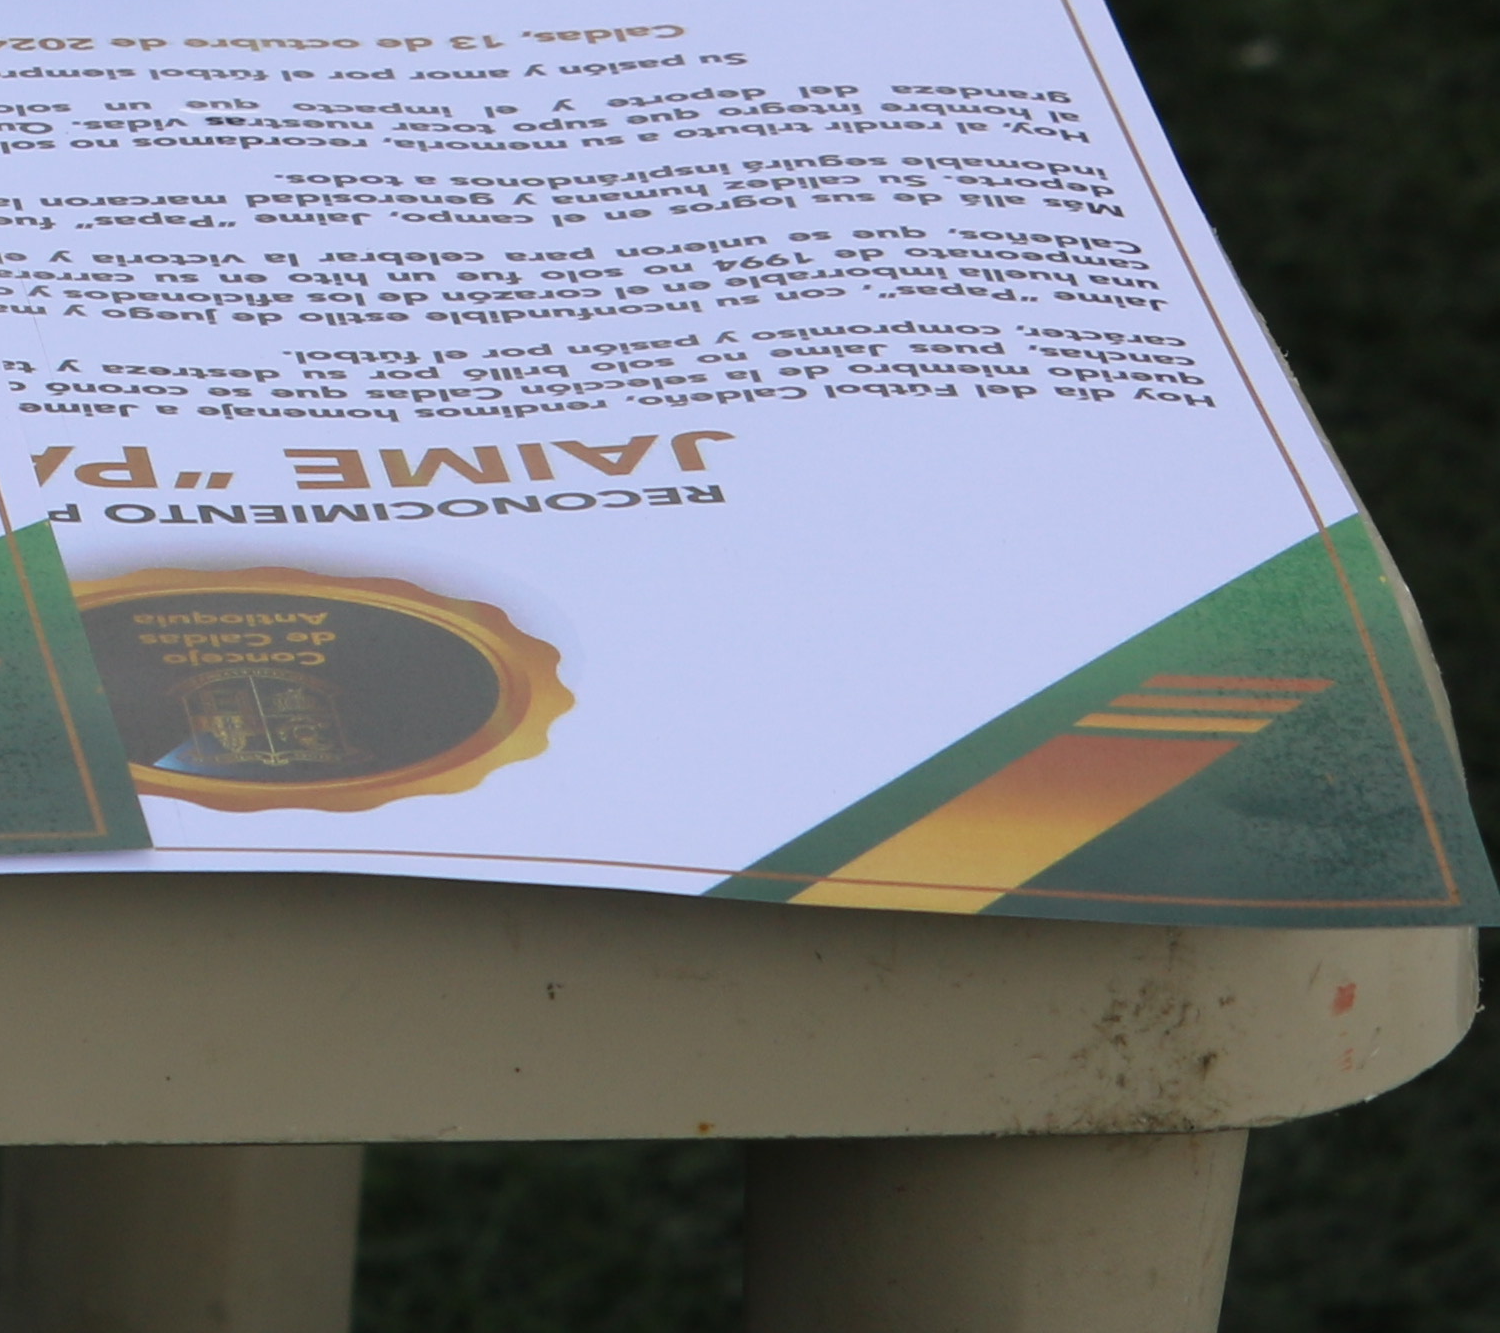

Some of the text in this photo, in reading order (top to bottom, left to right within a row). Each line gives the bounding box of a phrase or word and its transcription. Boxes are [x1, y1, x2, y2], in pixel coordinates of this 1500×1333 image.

[448, 34, 505, 51] 13
[519, 24, 686, 45] Caldas,
[108, 38, 168, 51] de
[183, 38, 361, 52] octubre
[376, 37, 433, 52] de
[18, 383, 1217, 423] Hoy día del Fútbol Caldeño, rendimos homenaje a Jaime
[283, 430, 736, 490] JAIME
[104, 485, 726, 524] RECONOCIMIENTO
